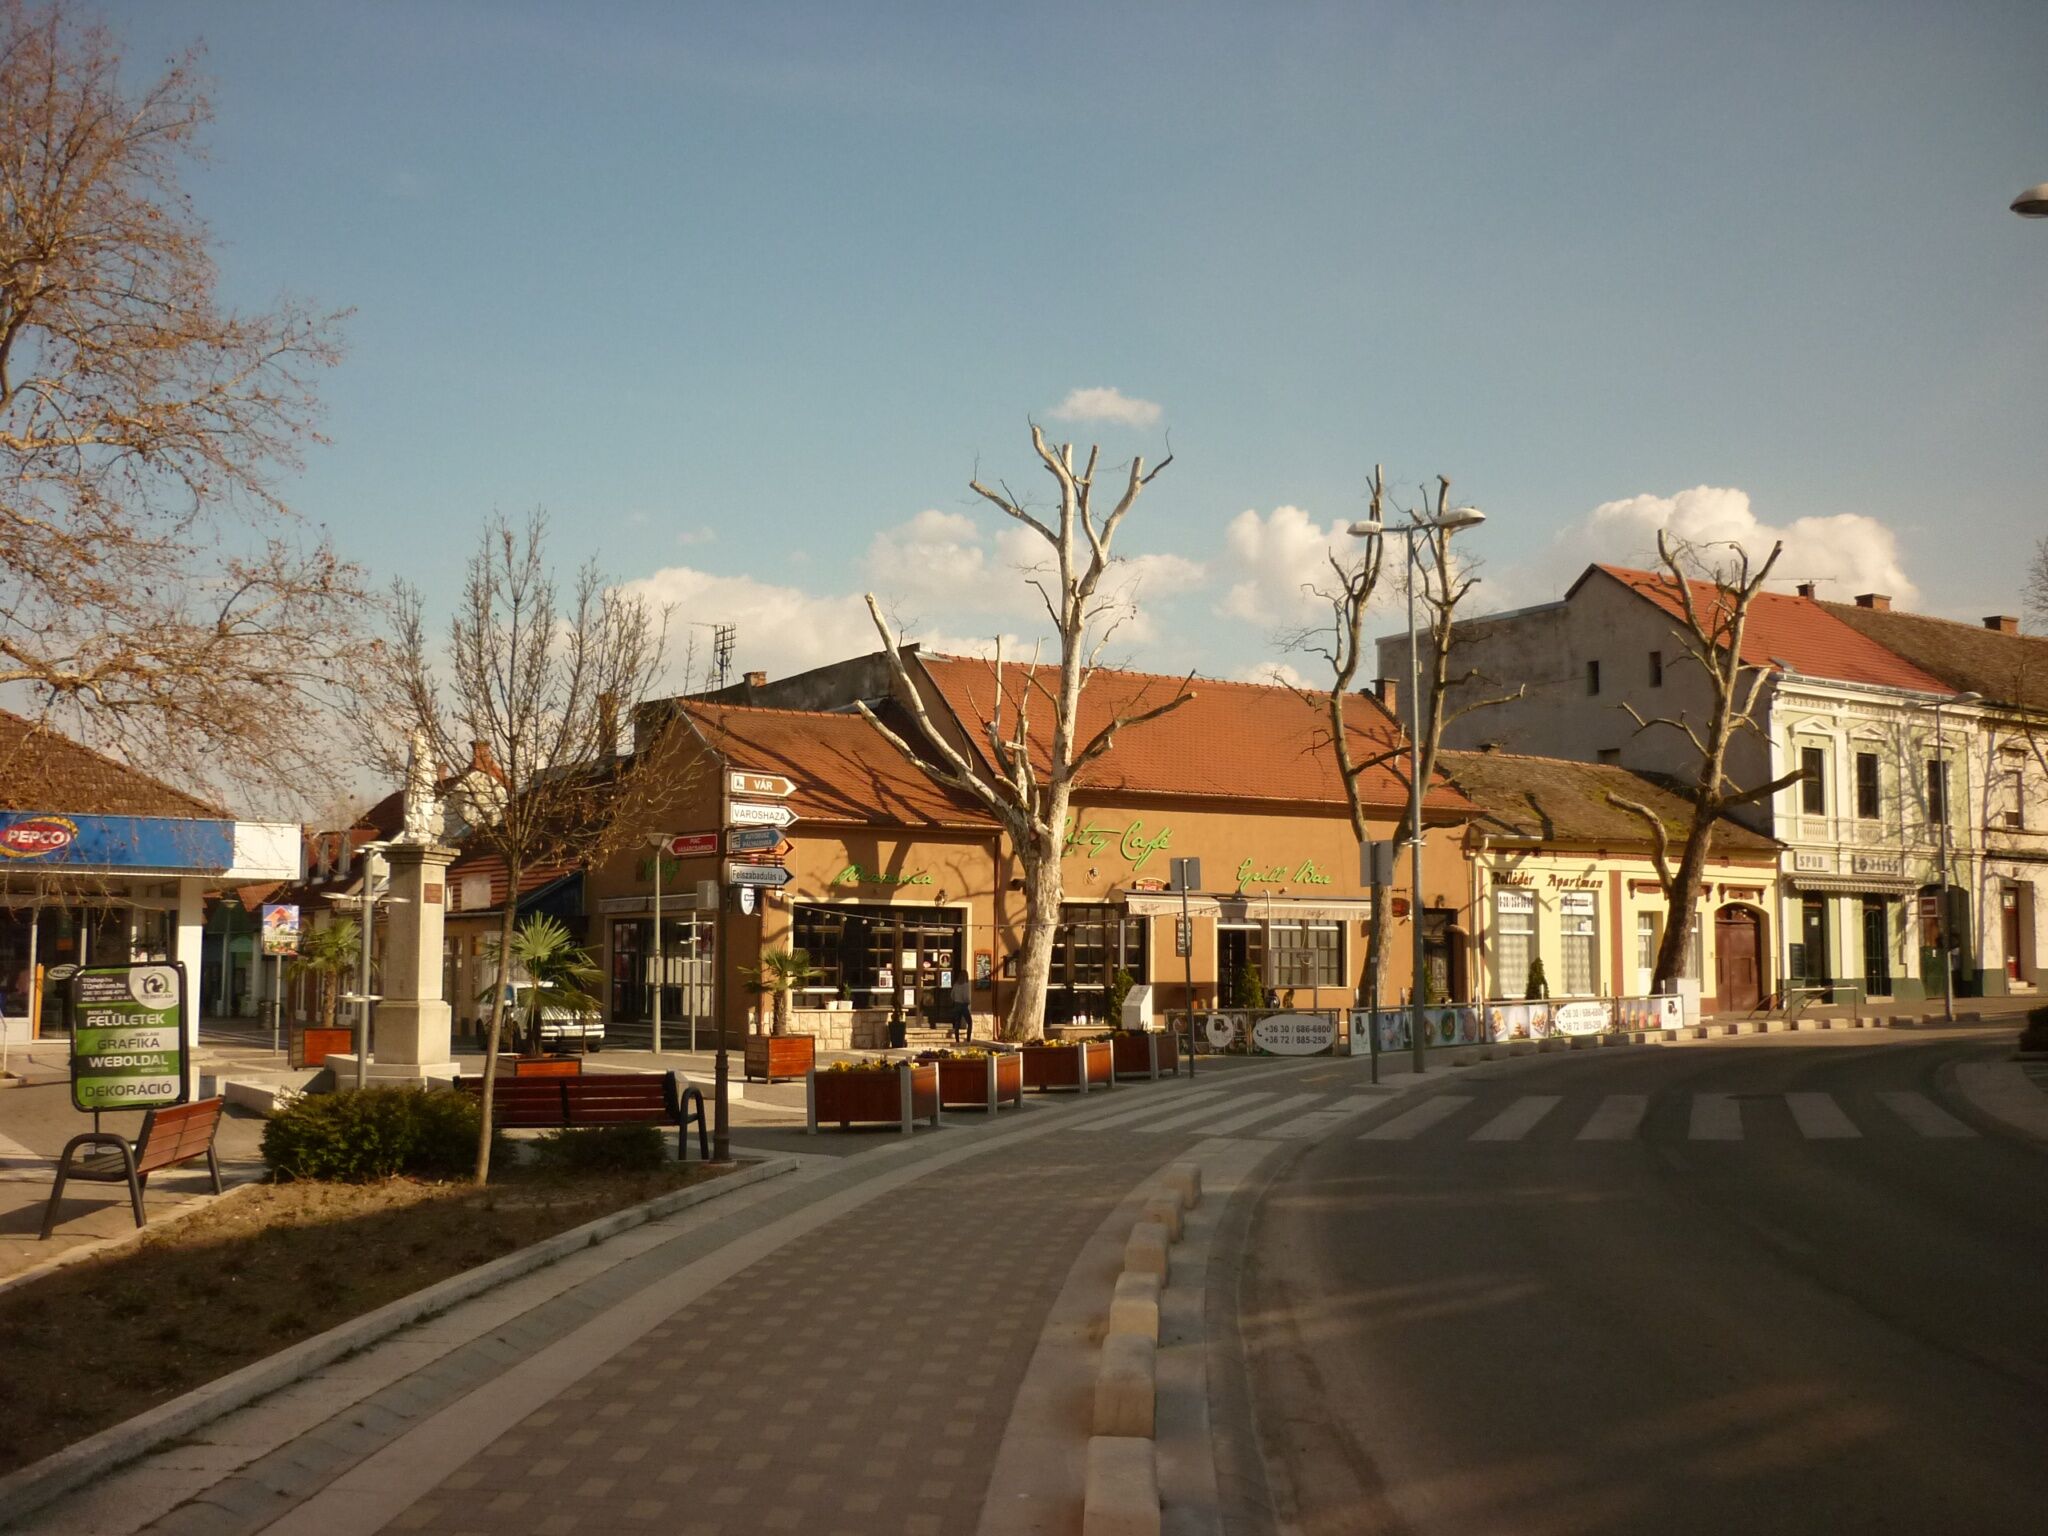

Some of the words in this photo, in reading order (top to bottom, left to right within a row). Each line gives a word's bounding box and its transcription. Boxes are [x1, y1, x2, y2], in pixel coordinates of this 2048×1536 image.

[754, 778, 773, 791] VÁR
[7, 829, 66, 844] PEPCO
[1119, 819, 1173, 872] Café
[1546, 873, 1603, 892] Apartman
[86, 1013, 165, 1027] FELÜLETEK
[97, 1038, 160, 1049] GRAFIKA
[89, 1055, 169, 1067] WEBOLDAL
[85, 1081, 172, 1097] DEKORÁCIÓ
